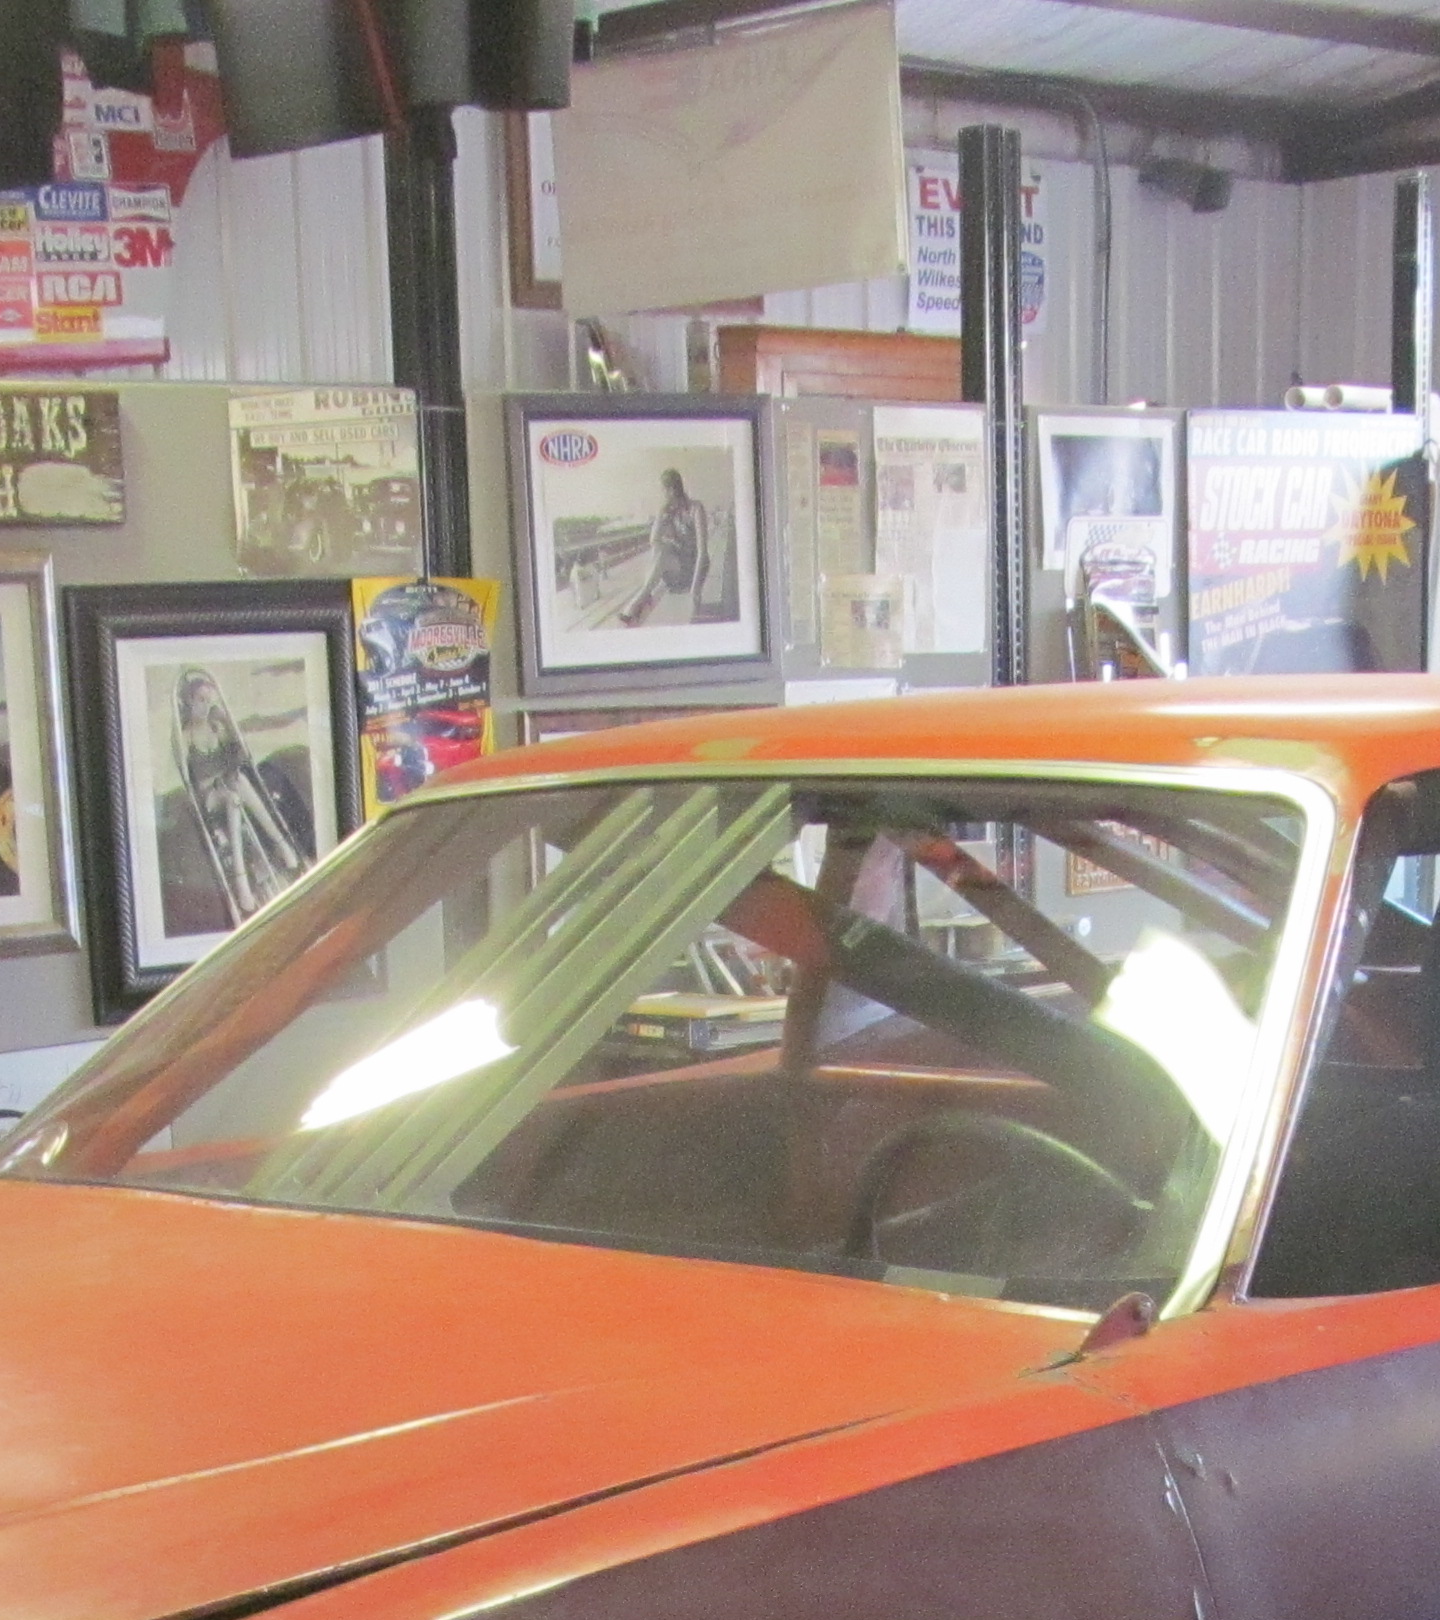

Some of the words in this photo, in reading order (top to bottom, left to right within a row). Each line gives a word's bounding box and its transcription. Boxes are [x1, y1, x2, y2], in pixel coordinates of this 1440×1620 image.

[94, 103, 141, 124] MCI
[39, 183, 101, 212] CLEVITE
[920, 176, 1040, 218] EVT
[916, 215, 956, 238] THIS
[113, 226, 176, 268] 3M
[917, 247, 956, 265] North
[42, 274, 117, 302] RCA
[314, 428, 335, 442] SELL
[340, 426, 367, 440] USED
[371, 423, 397, 439] CARS
[1190, 427, 1232, 456] RACE
[1237, 427, 1267, 456] CAR
[1273, 428, 1318, 457] RADIO
[547, 433, 592, 461] NHRA
[1200, 466, 1282, 531] STOCK
[1281, 466, 1333, 531] CAR
[1340, 510, 1401, 529] DAYTONA
[1238, 538, 1321, 565] RACING
[410, 623, 487, 652] MOORESVILLE
